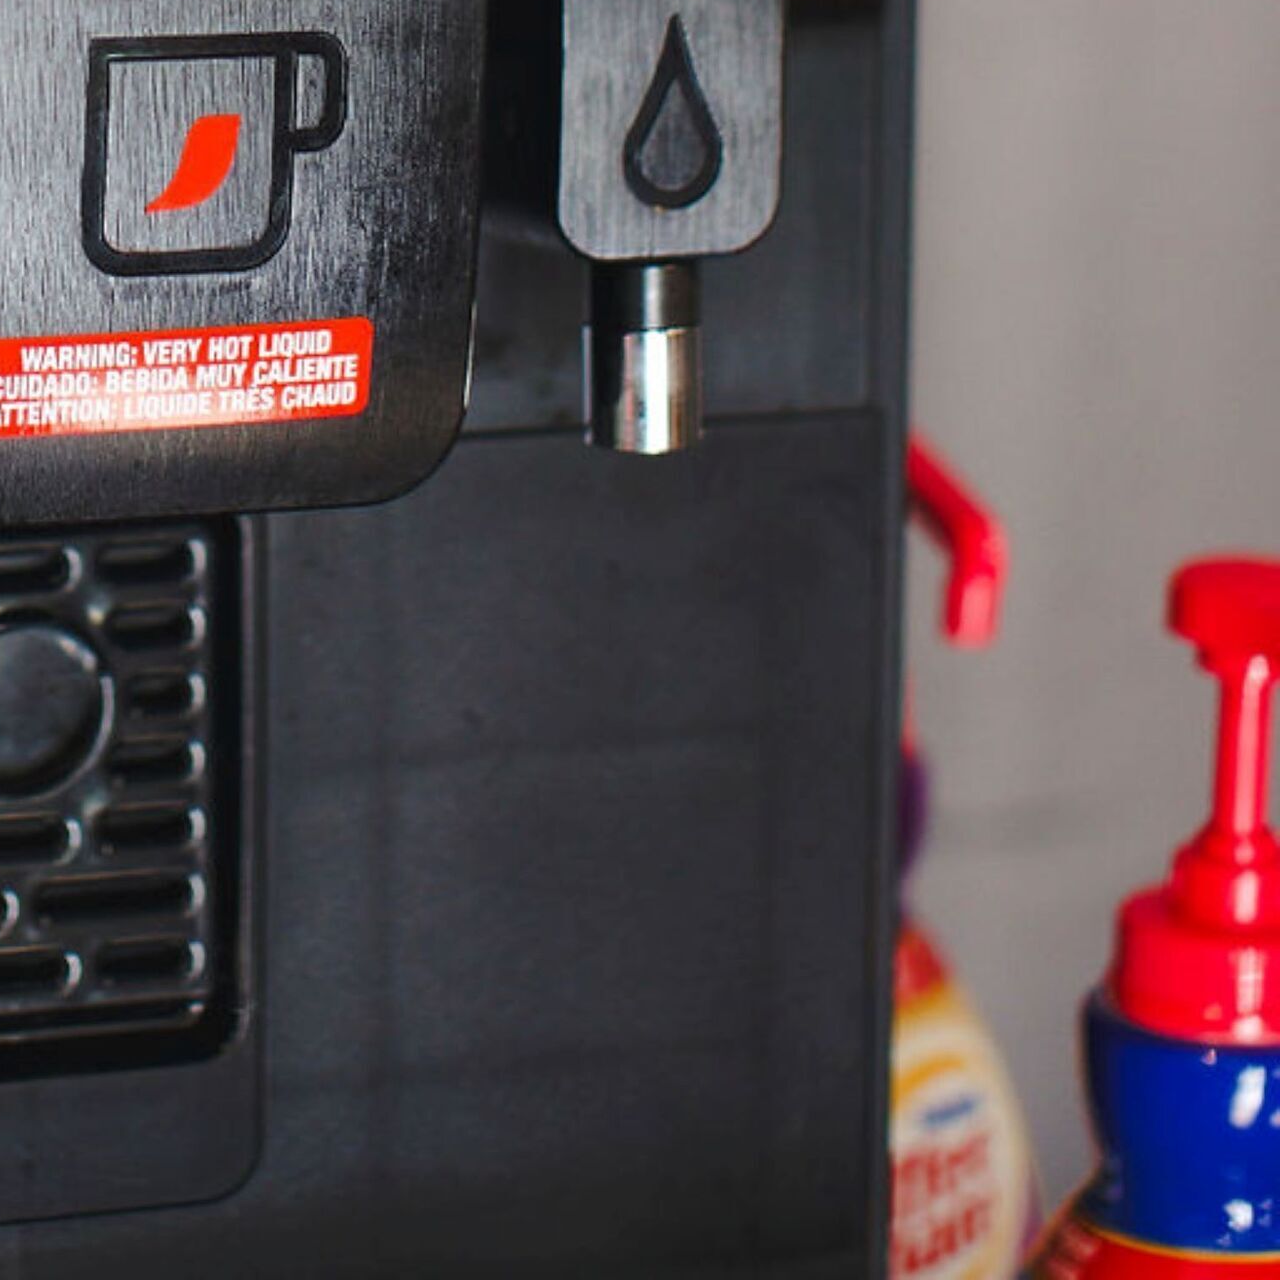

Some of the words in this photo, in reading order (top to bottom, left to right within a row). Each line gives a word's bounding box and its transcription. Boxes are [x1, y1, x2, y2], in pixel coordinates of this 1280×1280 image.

[21, 341, 138, 372] WARNING:
[143, 338, 202, 365] VERY
[208, 335, 253, 361] HOT
[259, 329, 332, 358] LIQUID
[105, 365, 188, 394] BEBIDA
[196, 361, 247, 388] MUY
[253, 354, 359, 385] CALIENTE
[124, 390, 212, 421] LIQUIDE
[281, 381, 358, 410] CHAUD
